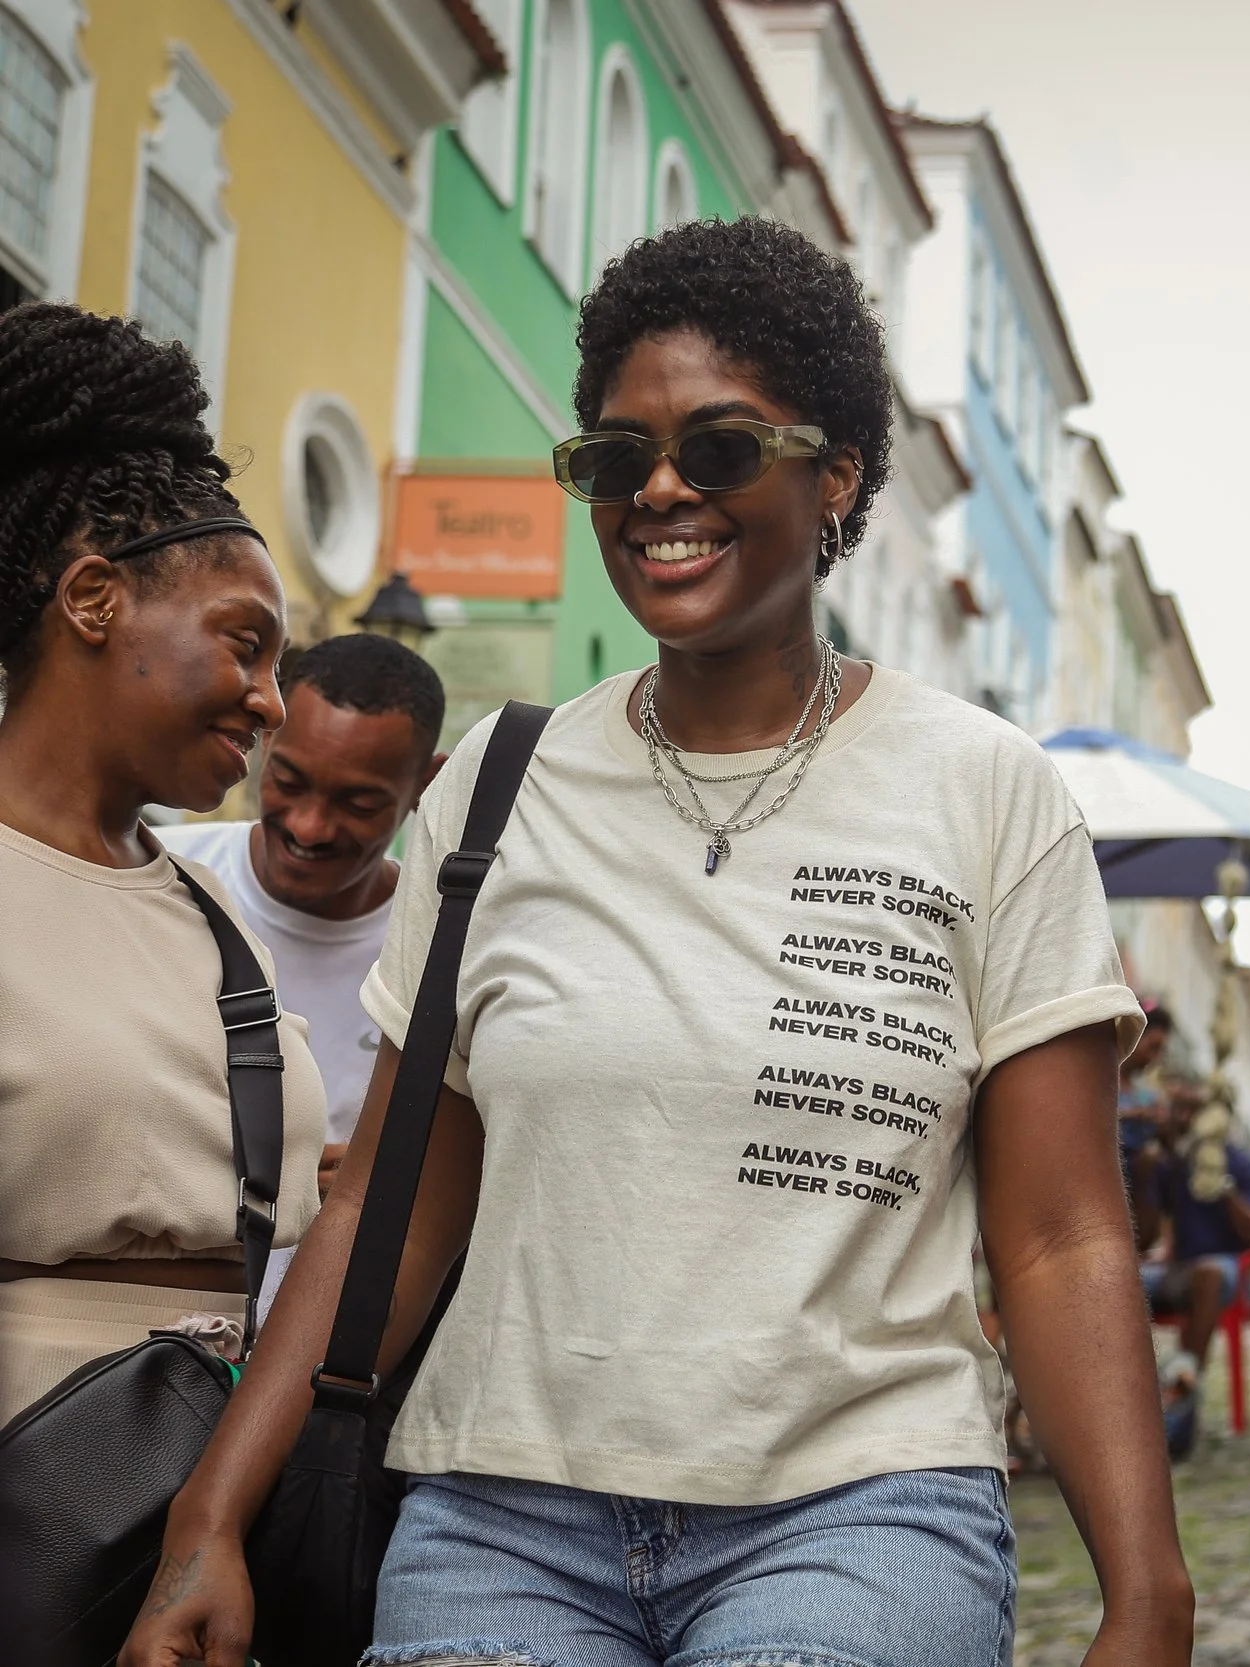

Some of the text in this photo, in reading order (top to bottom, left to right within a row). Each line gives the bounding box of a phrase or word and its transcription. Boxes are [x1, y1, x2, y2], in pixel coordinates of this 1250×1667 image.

[791, 889, 955, 930] NEVER SORRY.
[794, 867, 975, 922] ALWAYS BLACK,
[782, 934, 882, 956] ALWAYS
[780, 952, 953, 998] NEVER SORRY.
[770, 1017, 946, 1067] NEVER SORRY.
[773, 998, 956, 1053] ALWAYS BLACK,
[754, 1090, 928, 1138] NEVER SORRY.
[758, 1066, 941, 1121] ALWAYS BLACK,
[738, 1167, 901, 1210] NEVER SORRY.
[743, 1143, 920, 1193] ALWAYS BLACK,
